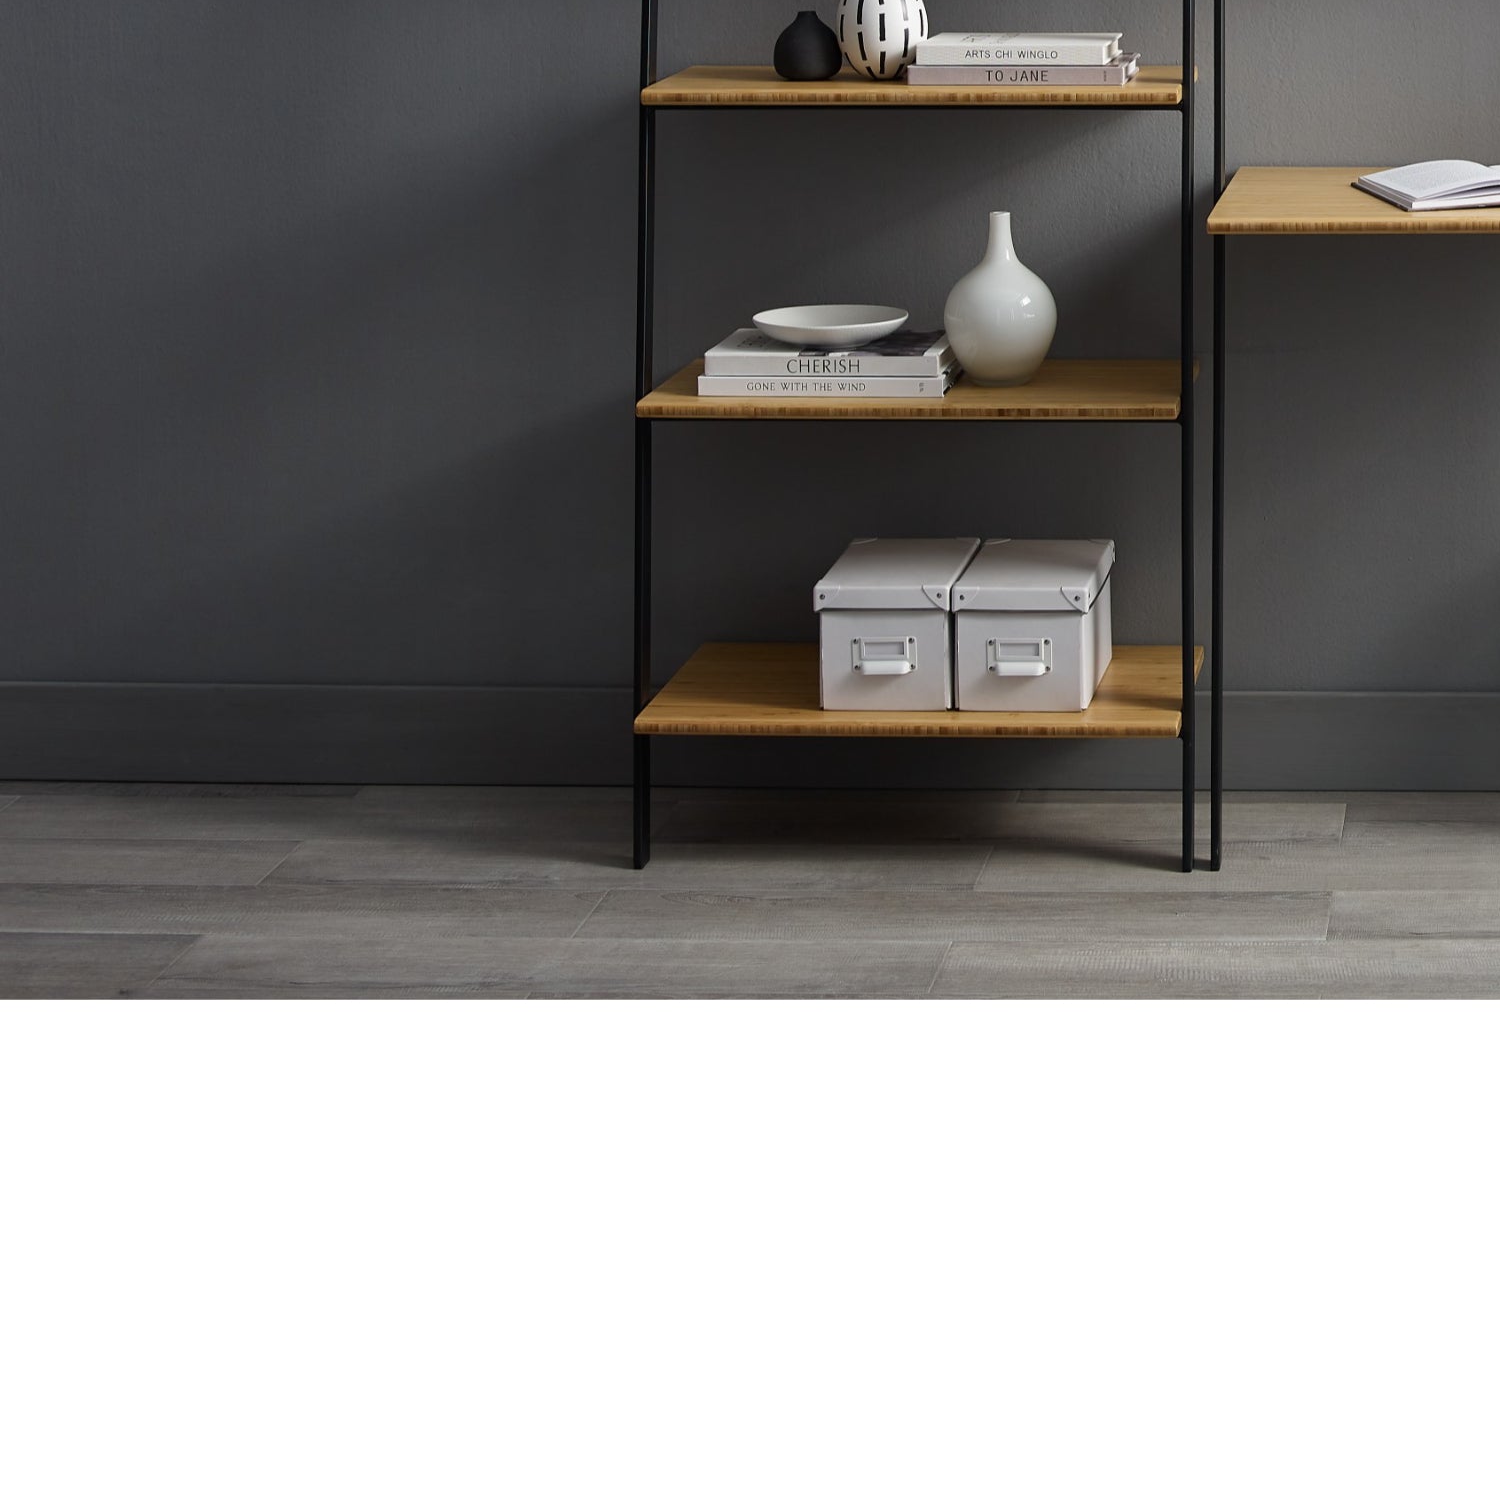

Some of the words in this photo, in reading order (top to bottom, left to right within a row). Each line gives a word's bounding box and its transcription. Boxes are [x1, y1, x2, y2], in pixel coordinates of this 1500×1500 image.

[965, 50, 991, 59] ARTS
[995, 50, 1013, 59] CHI
[1017, 50, 1059, 59] WINGLO
[985, 70, 1004, 82] TO
[1009, 70, 1049, 82] JANE
[786, 358, 861, 374] CHERISH
[746, 381, 776, 392] GONE
[780, 381, 808, 392] WITH
[812, 381, 833, 392] THE
[838, 381, 867, 392] WIND
